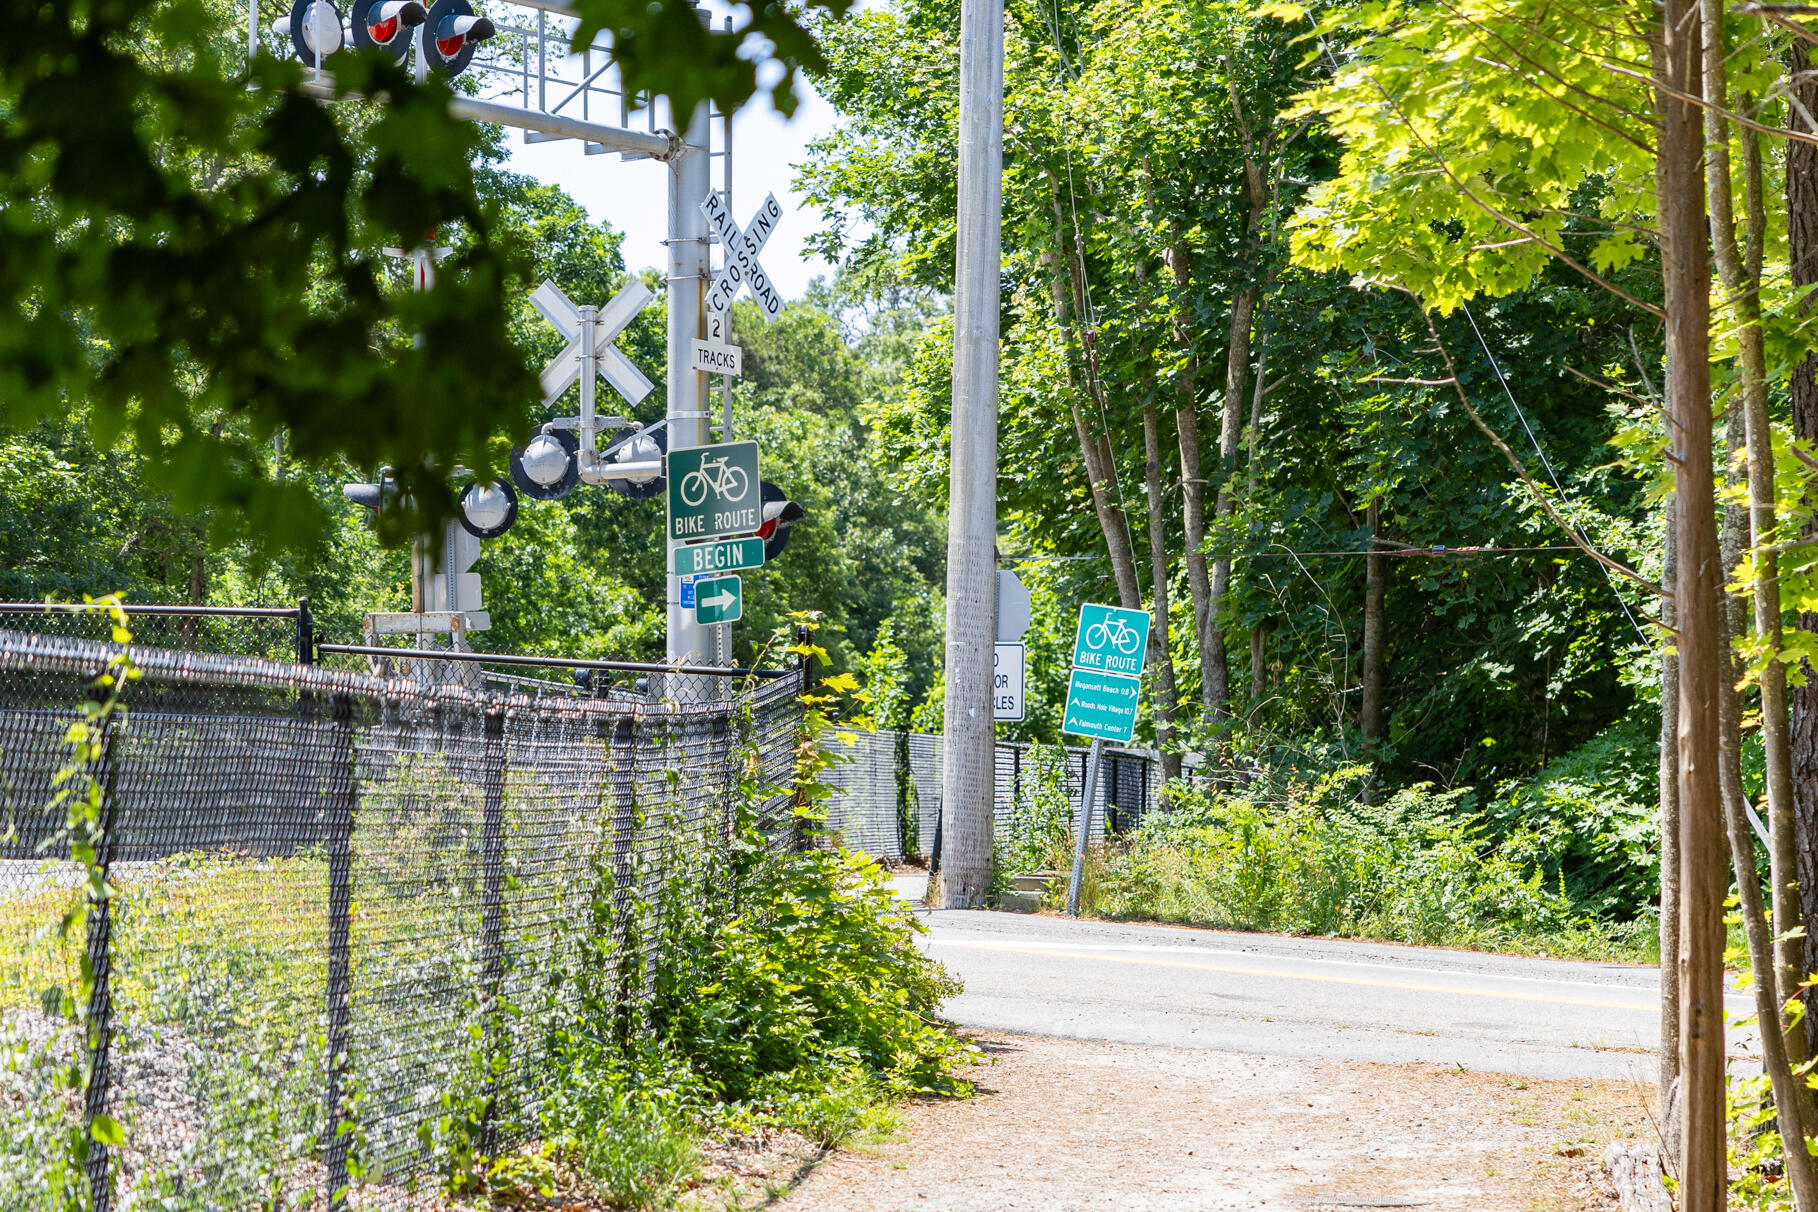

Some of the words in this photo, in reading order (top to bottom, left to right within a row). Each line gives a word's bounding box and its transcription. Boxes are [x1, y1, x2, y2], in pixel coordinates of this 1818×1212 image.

[706, 195, 741, 250] RAIL
[713, 200, 779, 312] CROSSING
[749, 262, 779, 314] ROAD
[712, 319, 720, 338] 2
[698, 348, 735, 369] TRACKS
[675, 515, 705, 535] BIKE
[714, 508, 756, 530] ROUTE
[693, 543, 743, 571] BEGIN
[1079, 651, 1102, 666] BIKE
[1105, 654, 1137, 671] ROUTE
[1075, 680, 1101, 691] Megansett
[1102, 684, 1119, 694] Beach
[1080, 700, 1095, 710] Woods
[1096, 703, 1107, 712] Hole
[1108, 704, 1123, 715] Village
[1079, 719, 1102, 730] Falmouth
[1104, 723, 1122, 733] Center
[1123, 726, 1127, 734] 7
